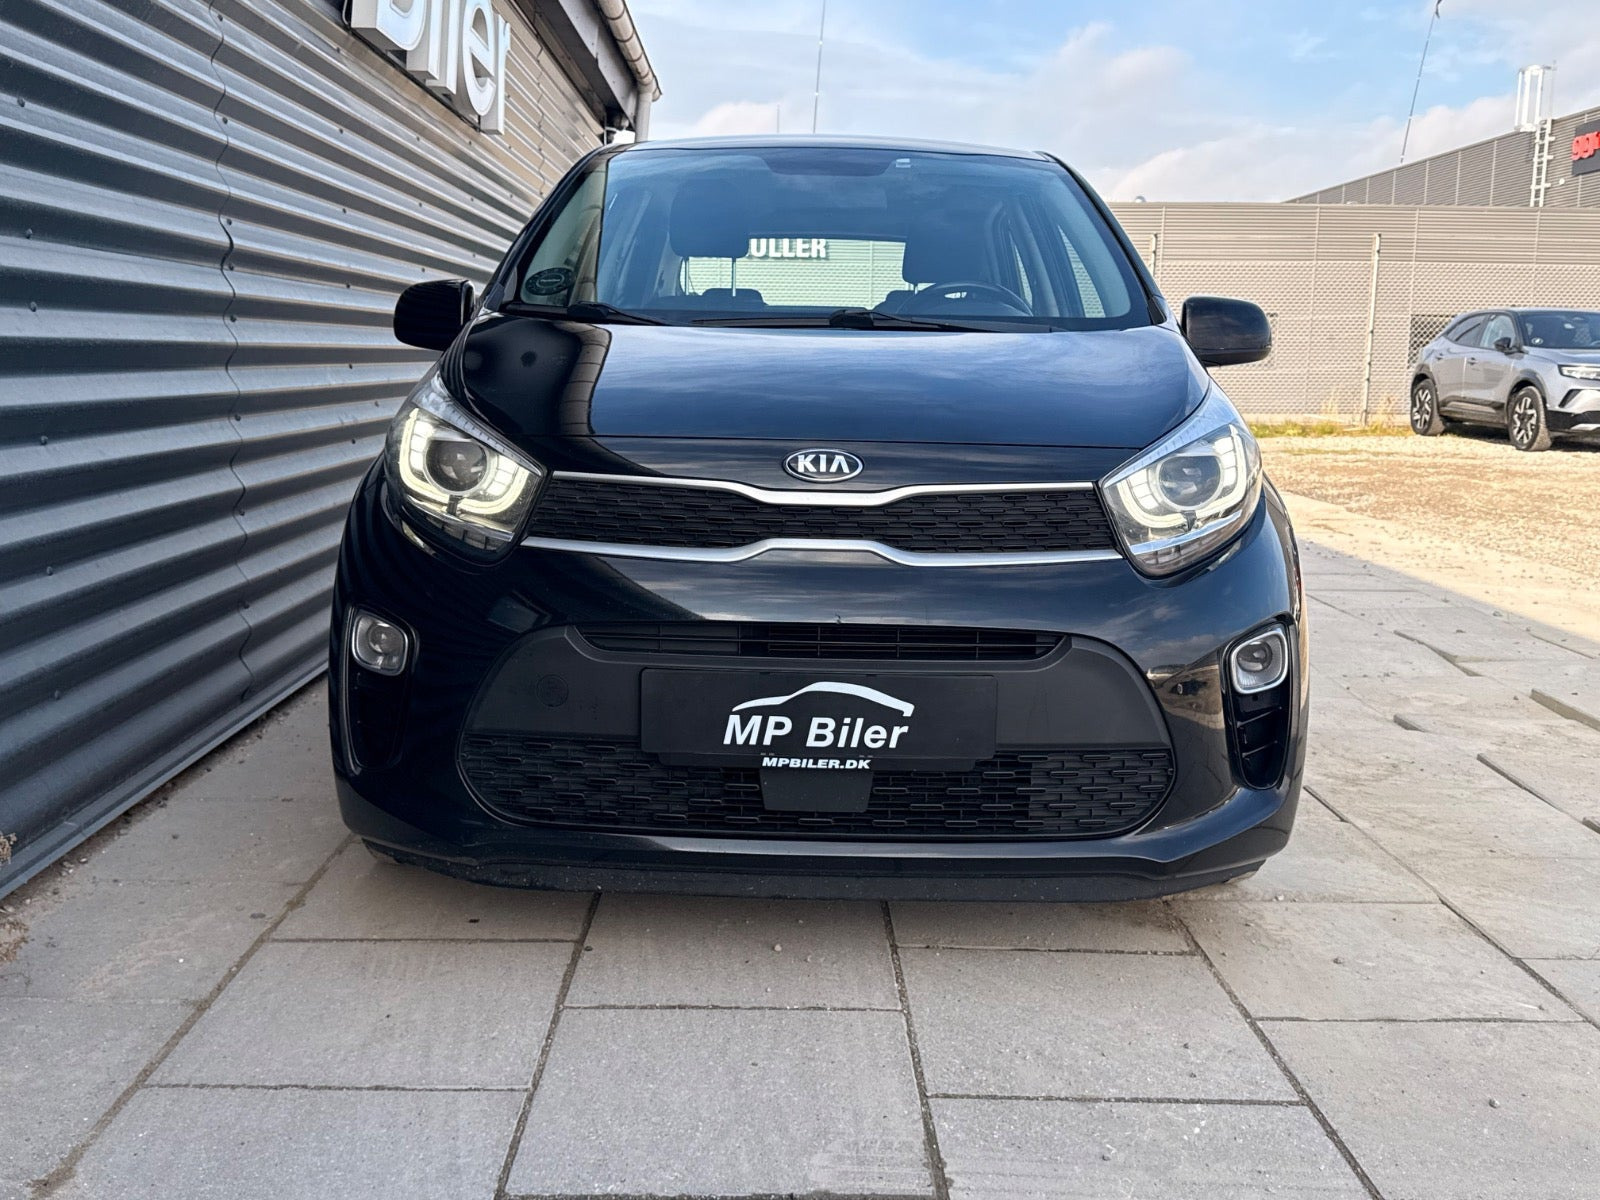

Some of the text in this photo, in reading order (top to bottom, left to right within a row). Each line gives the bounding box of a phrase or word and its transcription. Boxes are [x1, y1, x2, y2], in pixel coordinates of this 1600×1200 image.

[797, 454, 850, 474] KIA
[723, 714, 909, 749] MP Biler
[761, 757, 872, 770] MPBILER.DK
